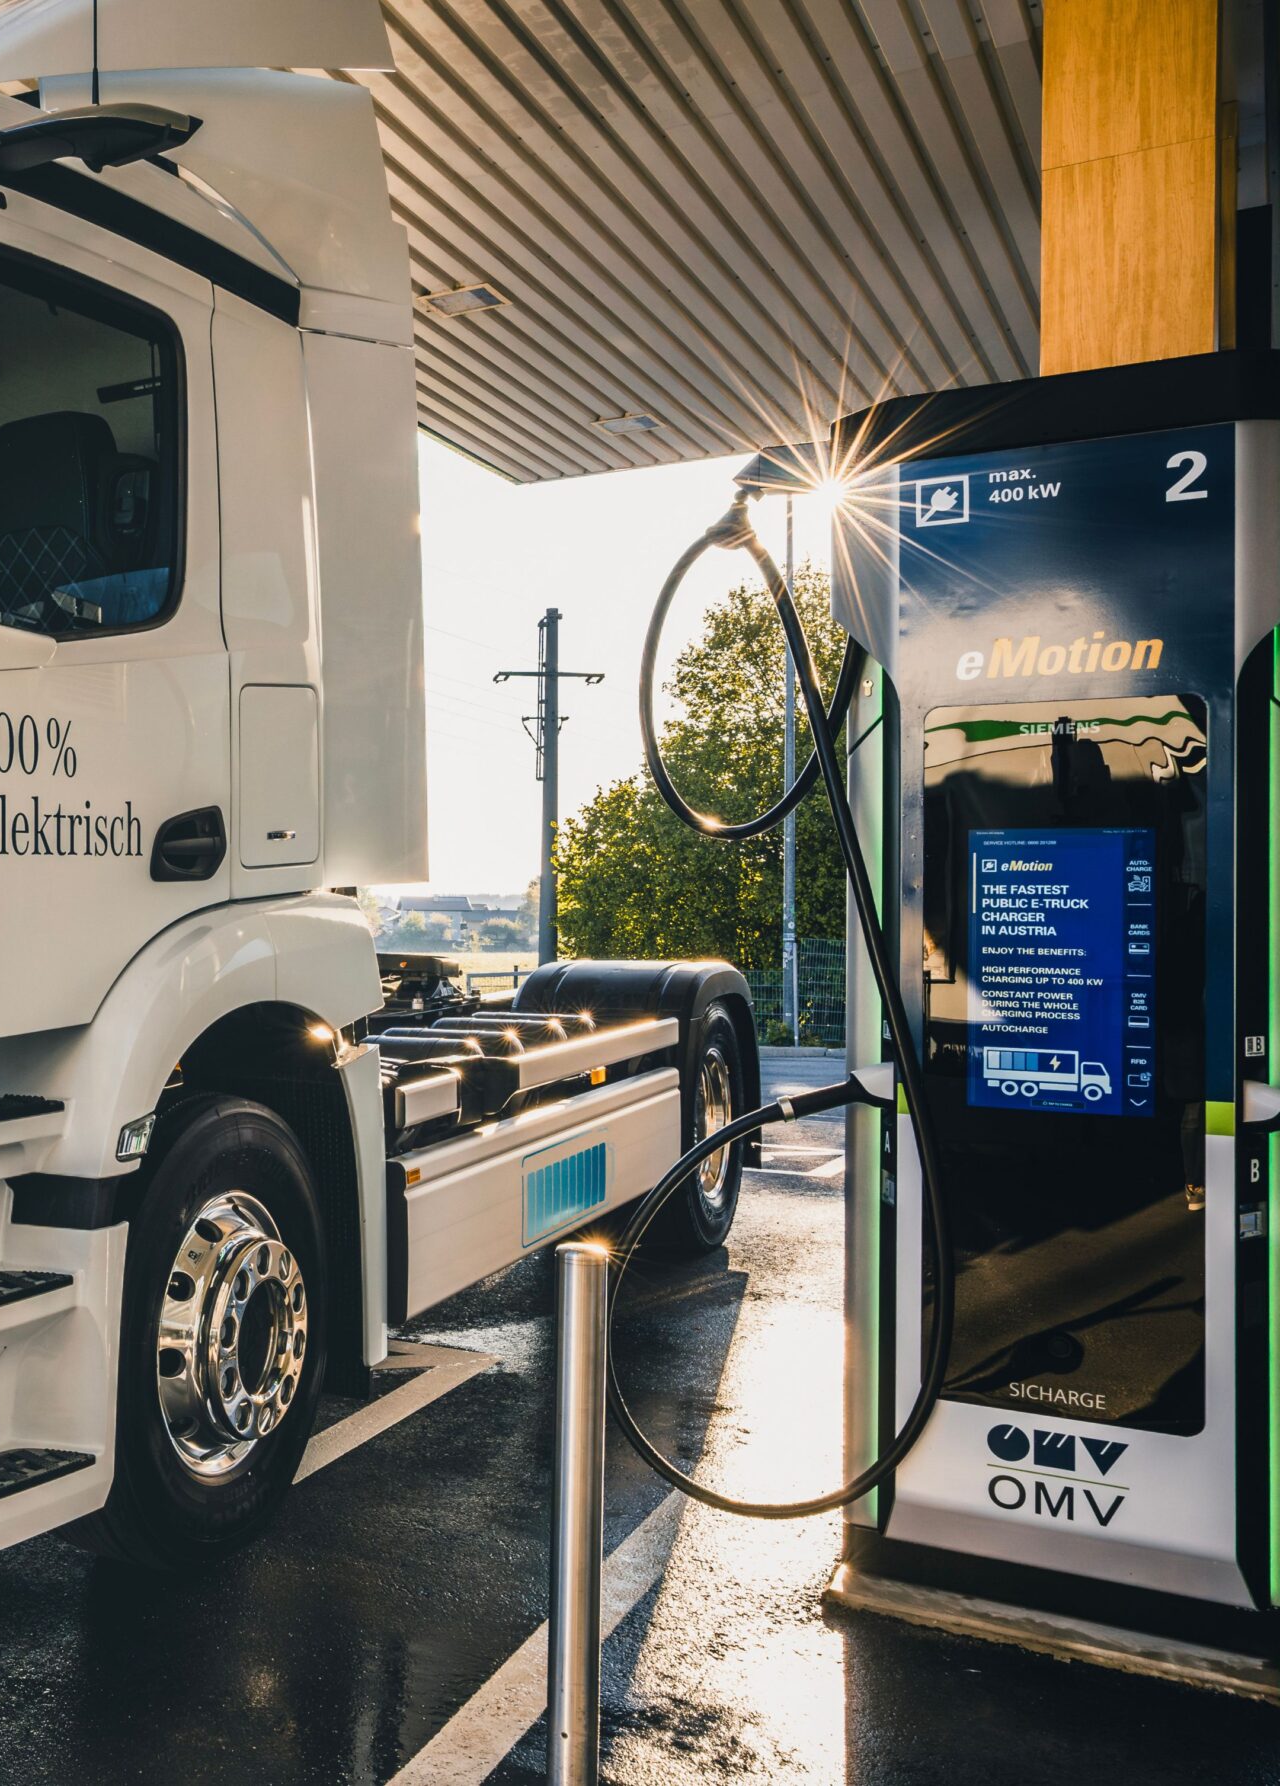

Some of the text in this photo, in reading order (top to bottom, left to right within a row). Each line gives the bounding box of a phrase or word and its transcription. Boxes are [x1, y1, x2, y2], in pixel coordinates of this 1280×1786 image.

[988, 468, 1037, 484] max.
[1165, 450, 1209, 503] 2
[988, 482, 1062, 504] 400 kW
[955, 631, 1164, 681] eMotion
[1019, 721, 1101, 737] SIEMENS
[1001, 860, 1053, 872] eMotion
[982, 884, 1069, 895] THE FASTEST
[982, 898, 1089, 909] PUBLIC E-TRUCK
[981, 911, 1045, 922] CHARGER
[981, 925, 1057, 936] IN AUSTRIA
[982, 946, 1087, 957] ENJOY THE BENEFITS:
[981, 965, 1081, 976] HIGH PERFORMANCE
[981, 975, 1104, 986] CHARGING UP TO 400 KW
[981, 990, 1074, 1001] CONSTANT POWER
[982, 999, 1079, 1011] DURING THE WHOLE
[982, 1009, 1081, 1021] CHARGING PROCESS
[981, 1024, 1049, 1034] AUTOCHARGE
[884, 1130, 891, 1153] A
[1250, 1158, 1260, 1183] B
[1009, 1382, 1107, 1410] SICHARGE
[987, 1474, 1125, 1527] OMV
